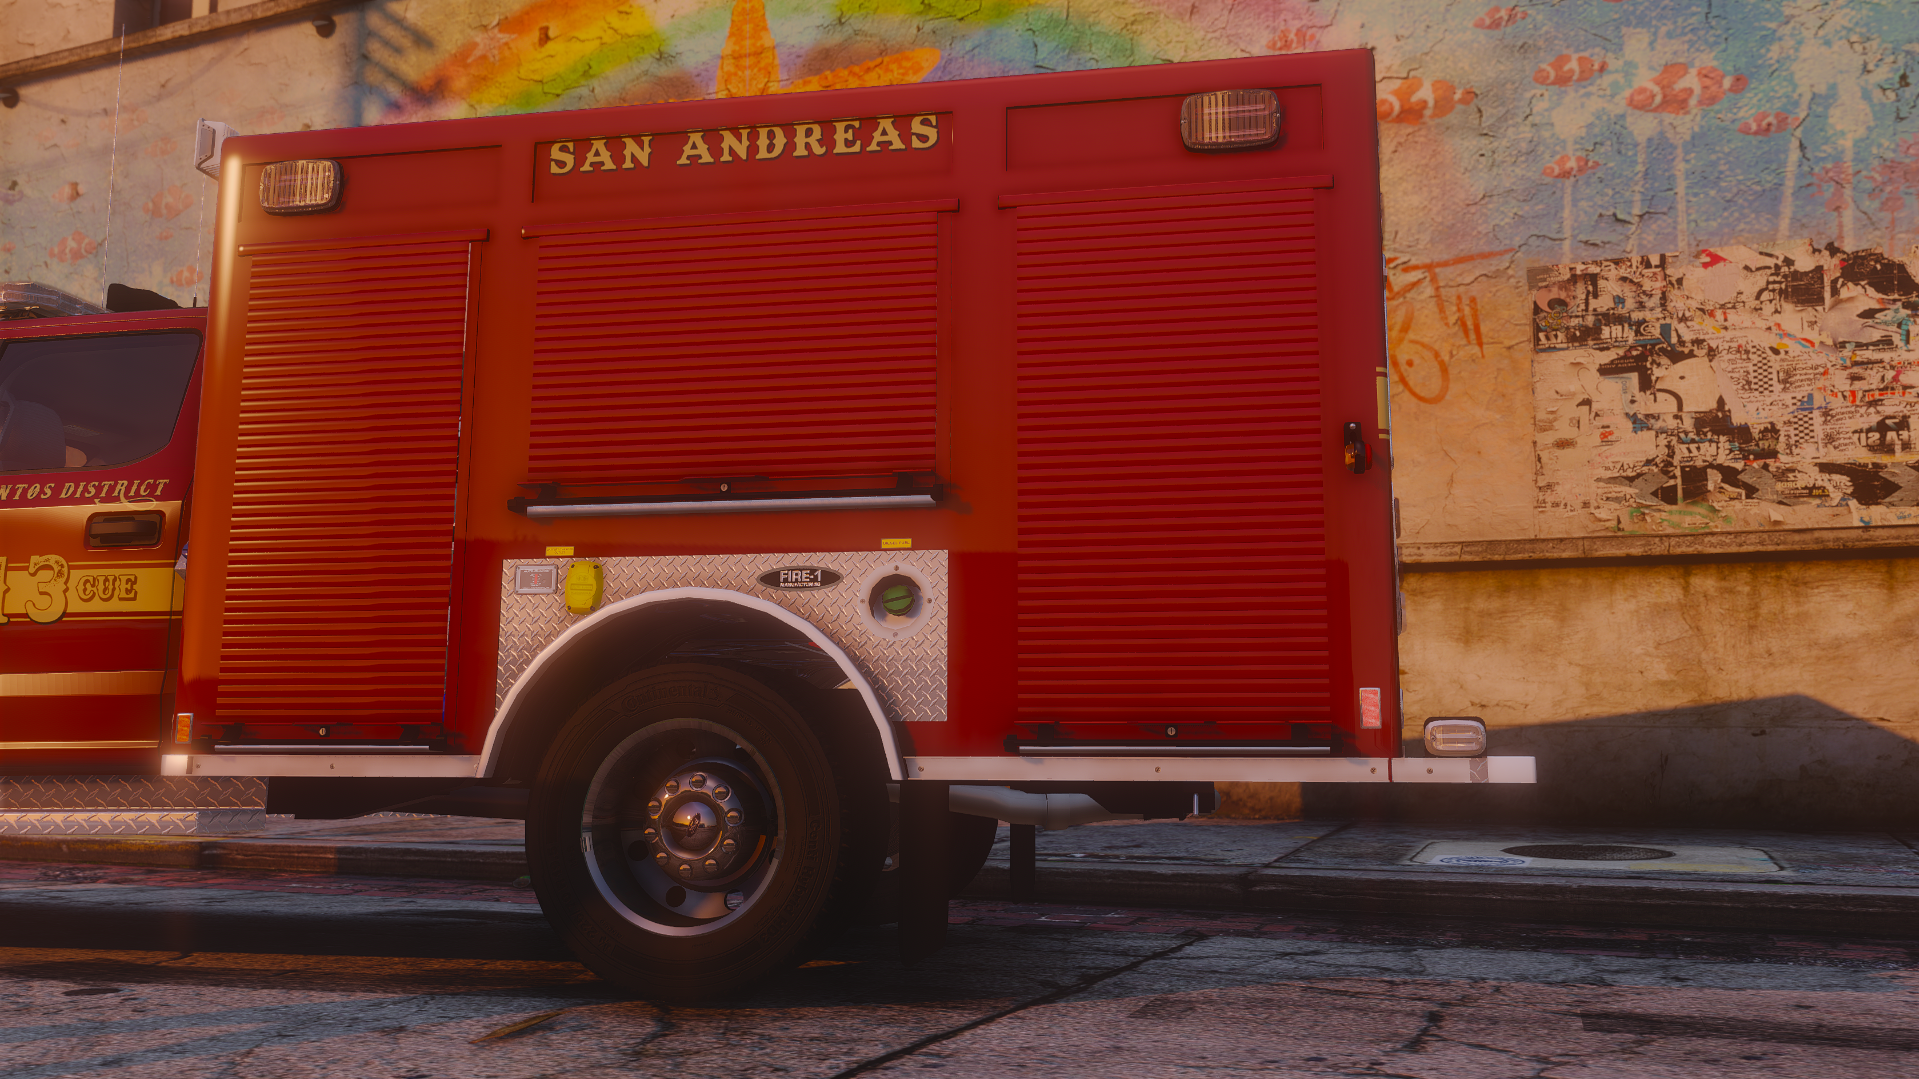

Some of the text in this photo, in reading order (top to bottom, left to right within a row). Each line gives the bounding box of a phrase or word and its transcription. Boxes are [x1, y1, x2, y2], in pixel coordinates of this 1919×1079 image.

[550, 112, 940, 174] SAN ANDREAS
[59, 479, 170, 510] DISTRICT
[76, 573, 138, 603] CUE
[780, 569, 822, 582] FIRE-1
[623, 682, 709, 713] Continental
